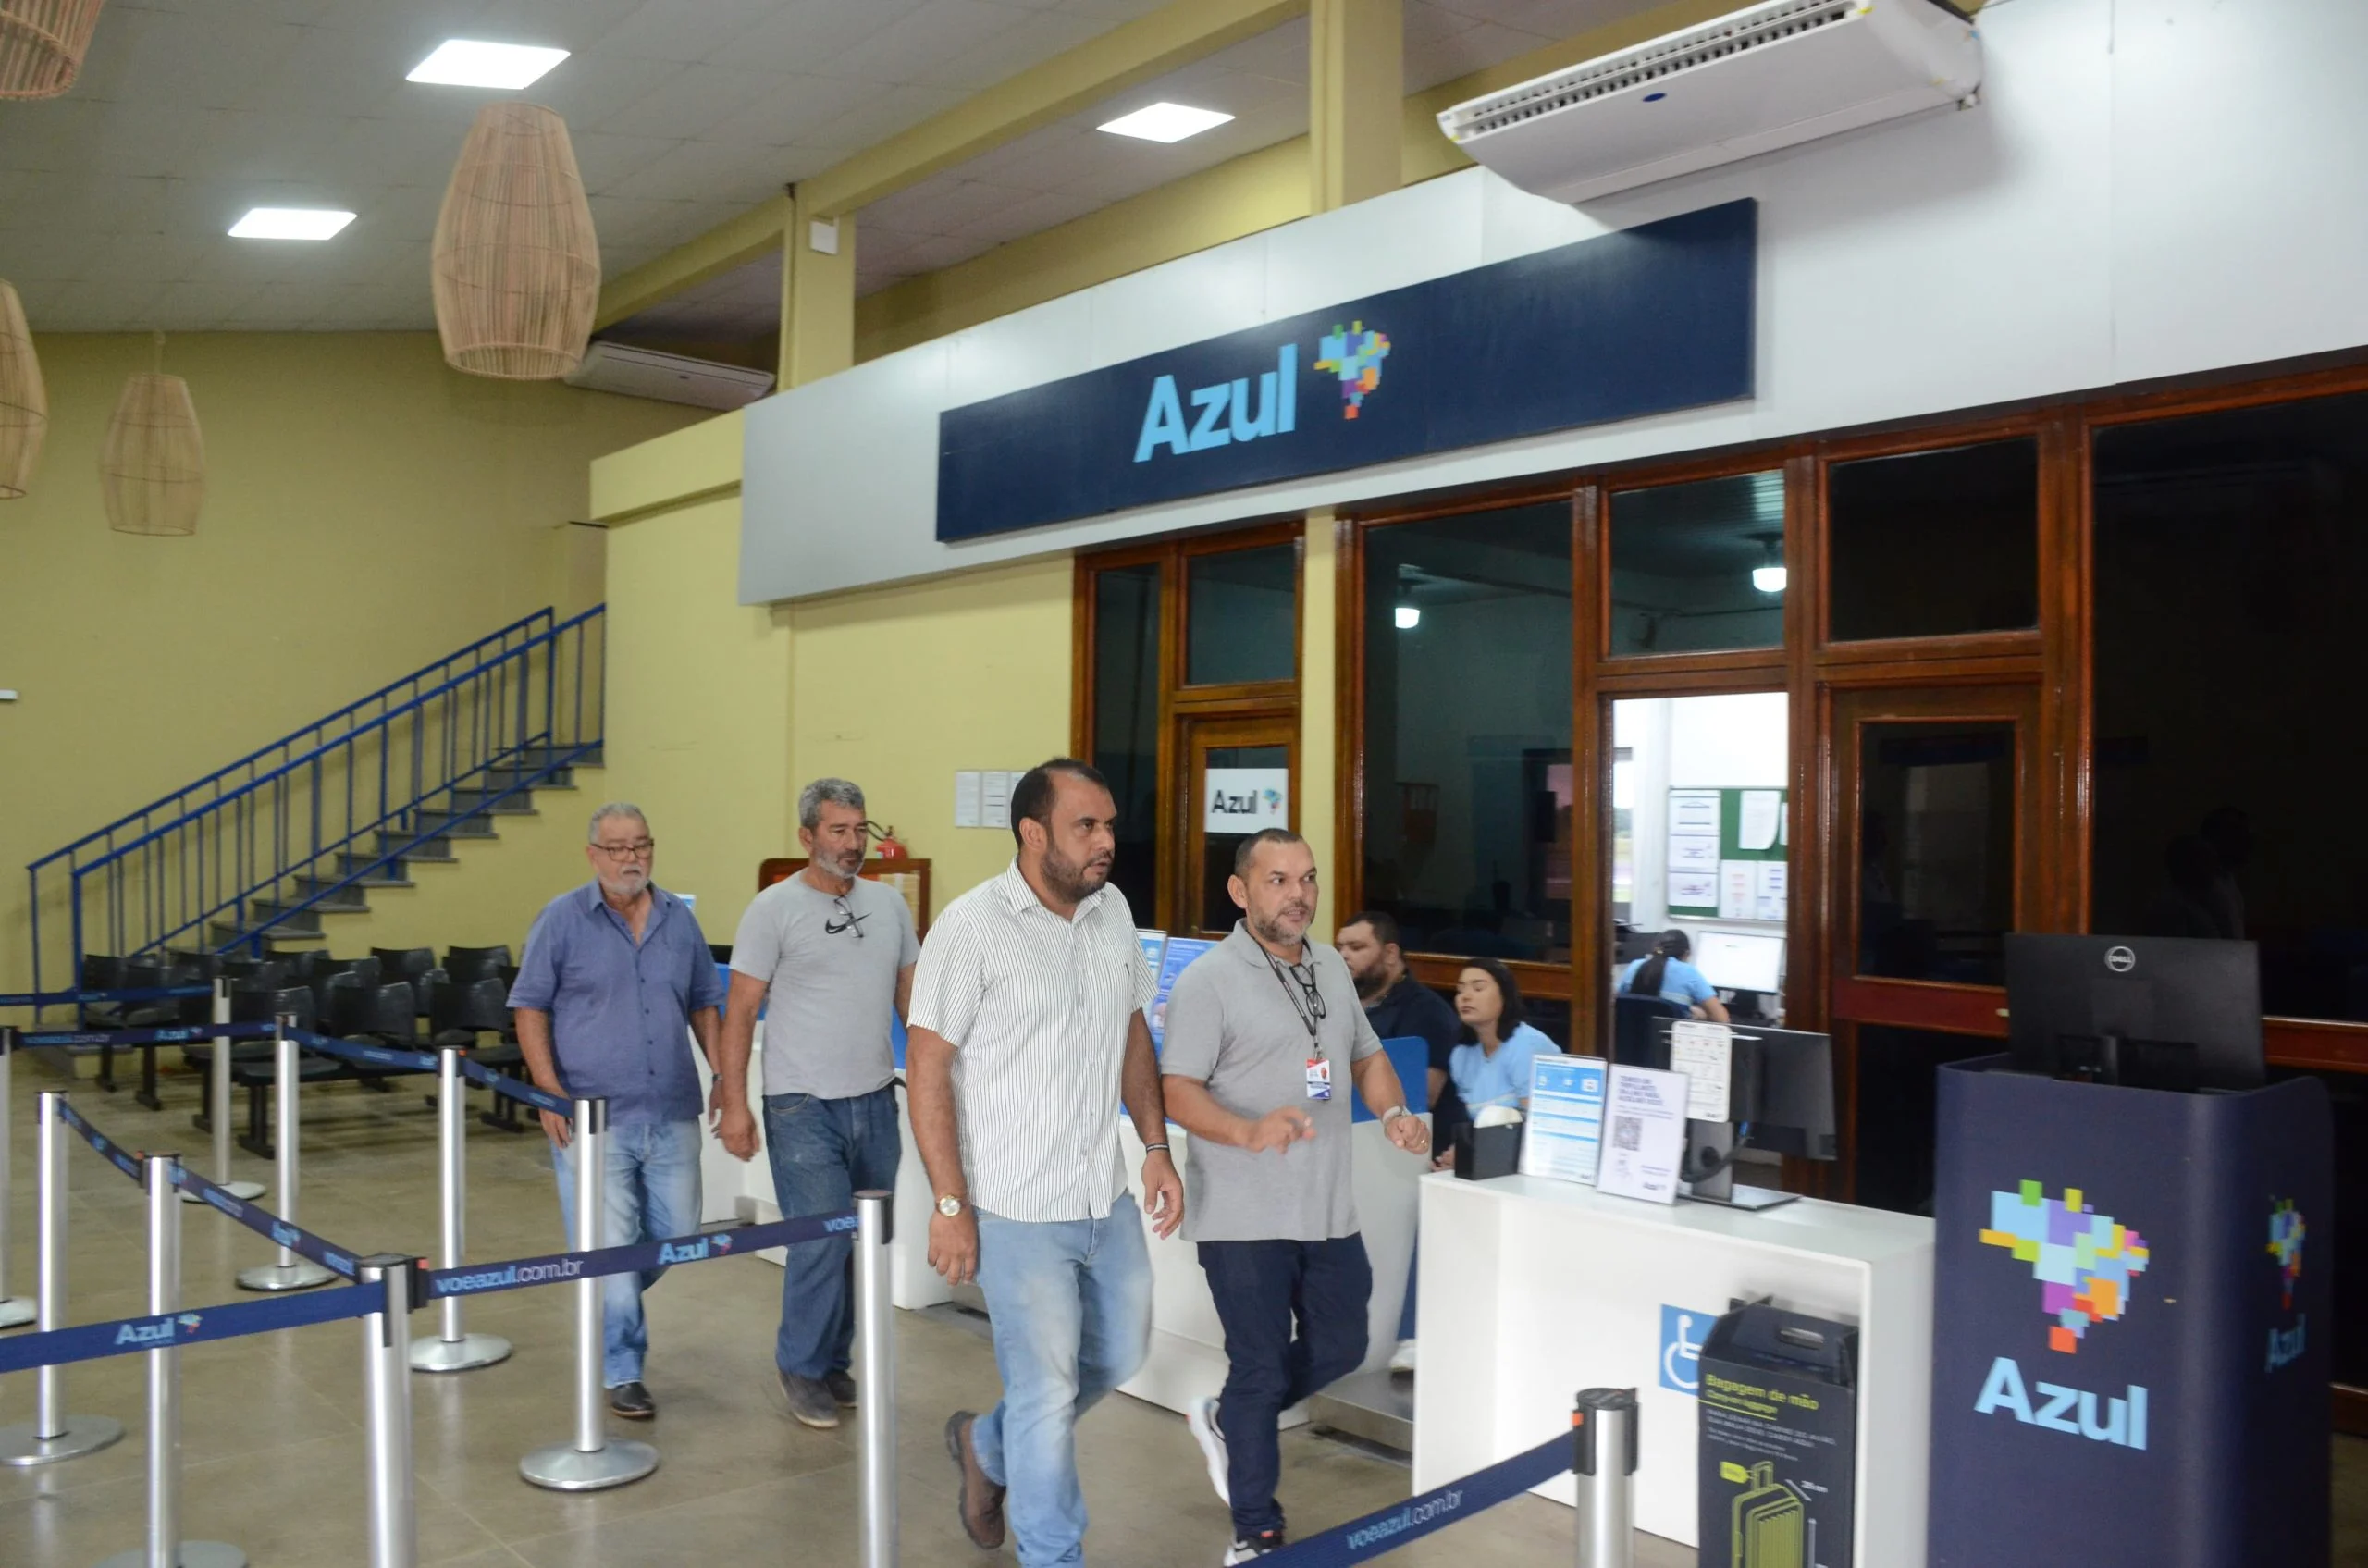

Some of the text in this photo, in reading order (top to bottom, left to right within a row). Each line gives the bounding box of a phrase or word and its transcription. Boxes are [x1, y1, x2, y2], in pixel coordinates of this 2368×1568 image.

[1134, 343, 1298, 463] Azul
[1211, 789, 1258, 814] Azul
[435, 1258, 585, 1293] voeazul.com.br
[658, 1232, 709, 1266] Azul
[115, 1317, 175, 1345] Azul
[2264, 1313, 2306, 1374] Azul
[1705, 1374, 1766, 1398] Bagagem
[1768, 1389, 1787, 1402] de
[1974, 1357, 2148, 1451] Azul
[1346, 1488, 1463, 1550] voeazul.com.br
